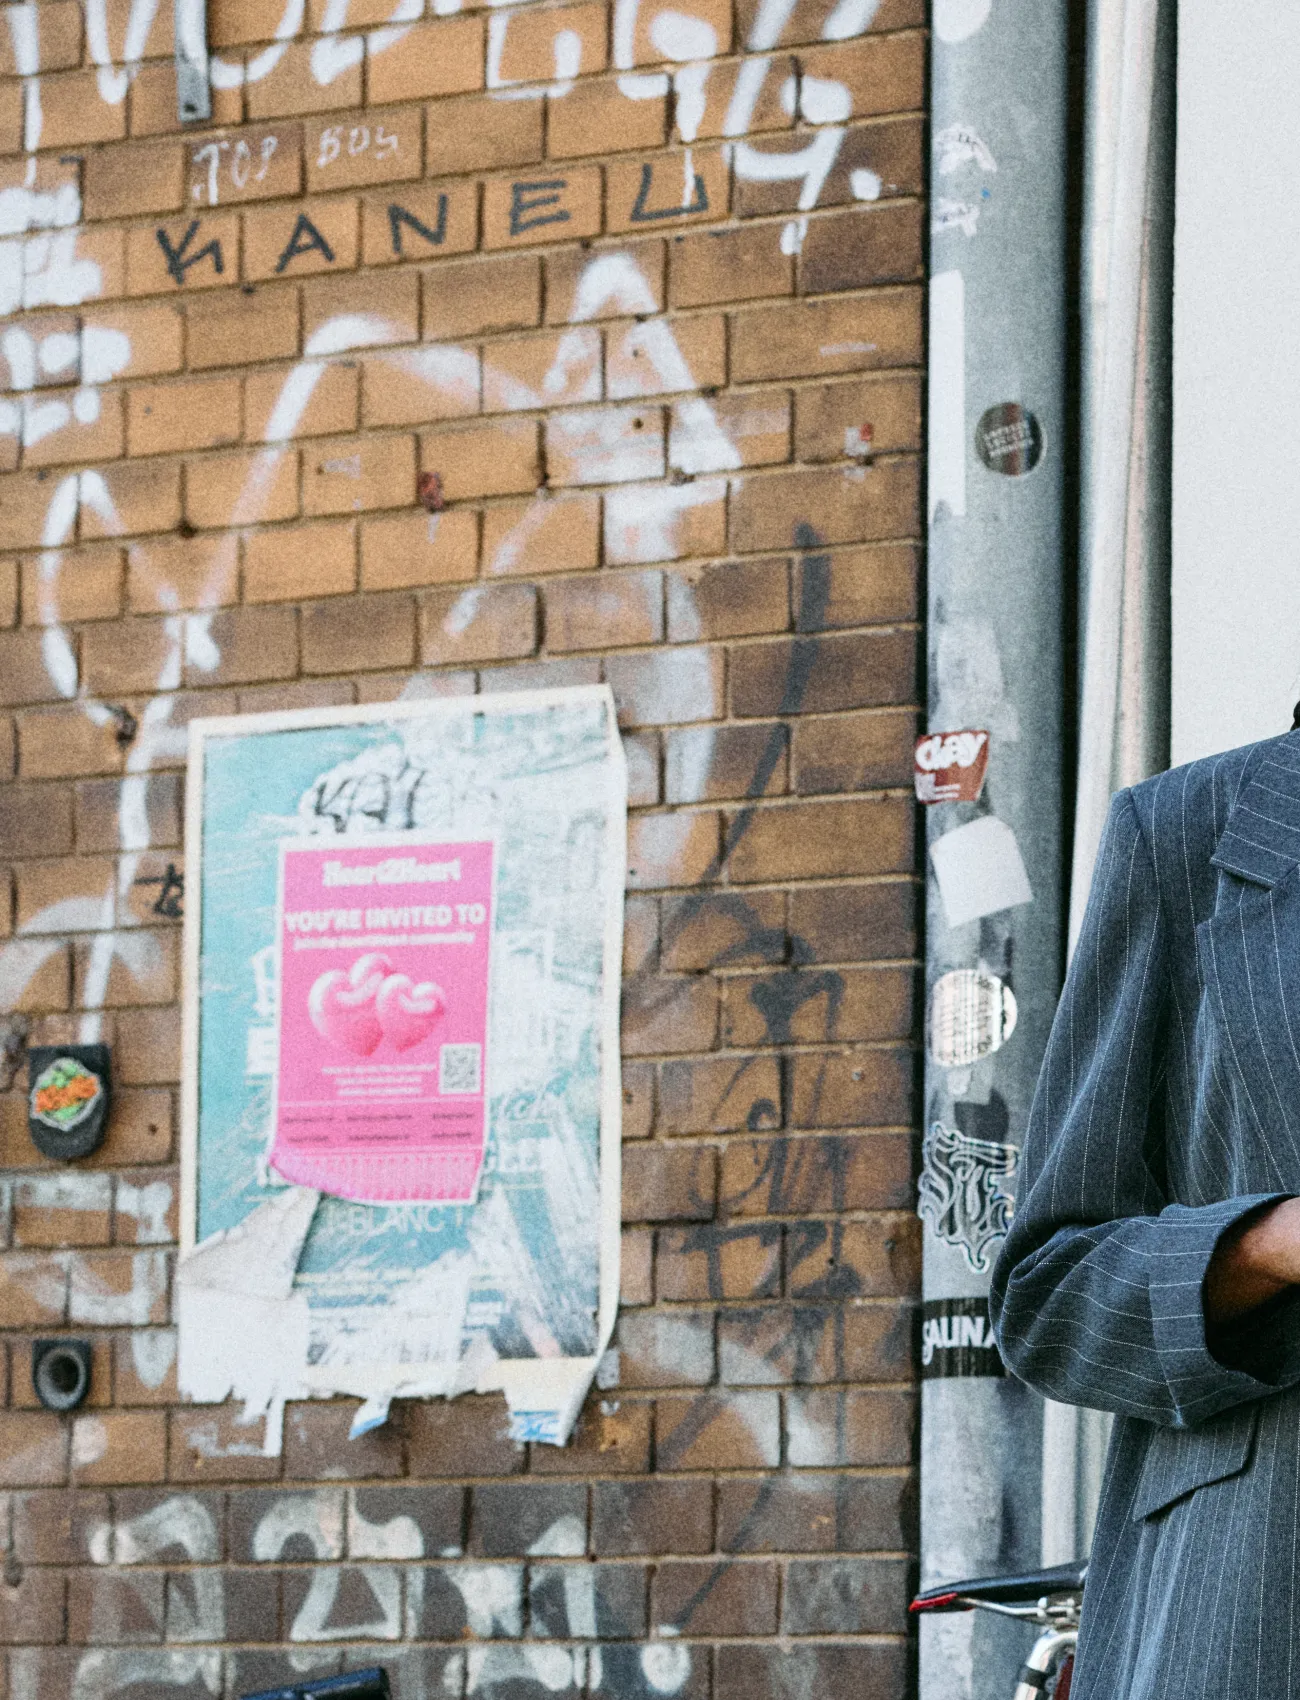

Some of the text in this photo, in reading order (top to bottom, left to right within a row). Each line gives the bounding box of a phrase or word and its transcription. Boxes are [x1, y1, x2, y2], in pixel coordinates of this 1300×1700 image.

[284, 902, 486, 932] YOU'RE INVITED TO
